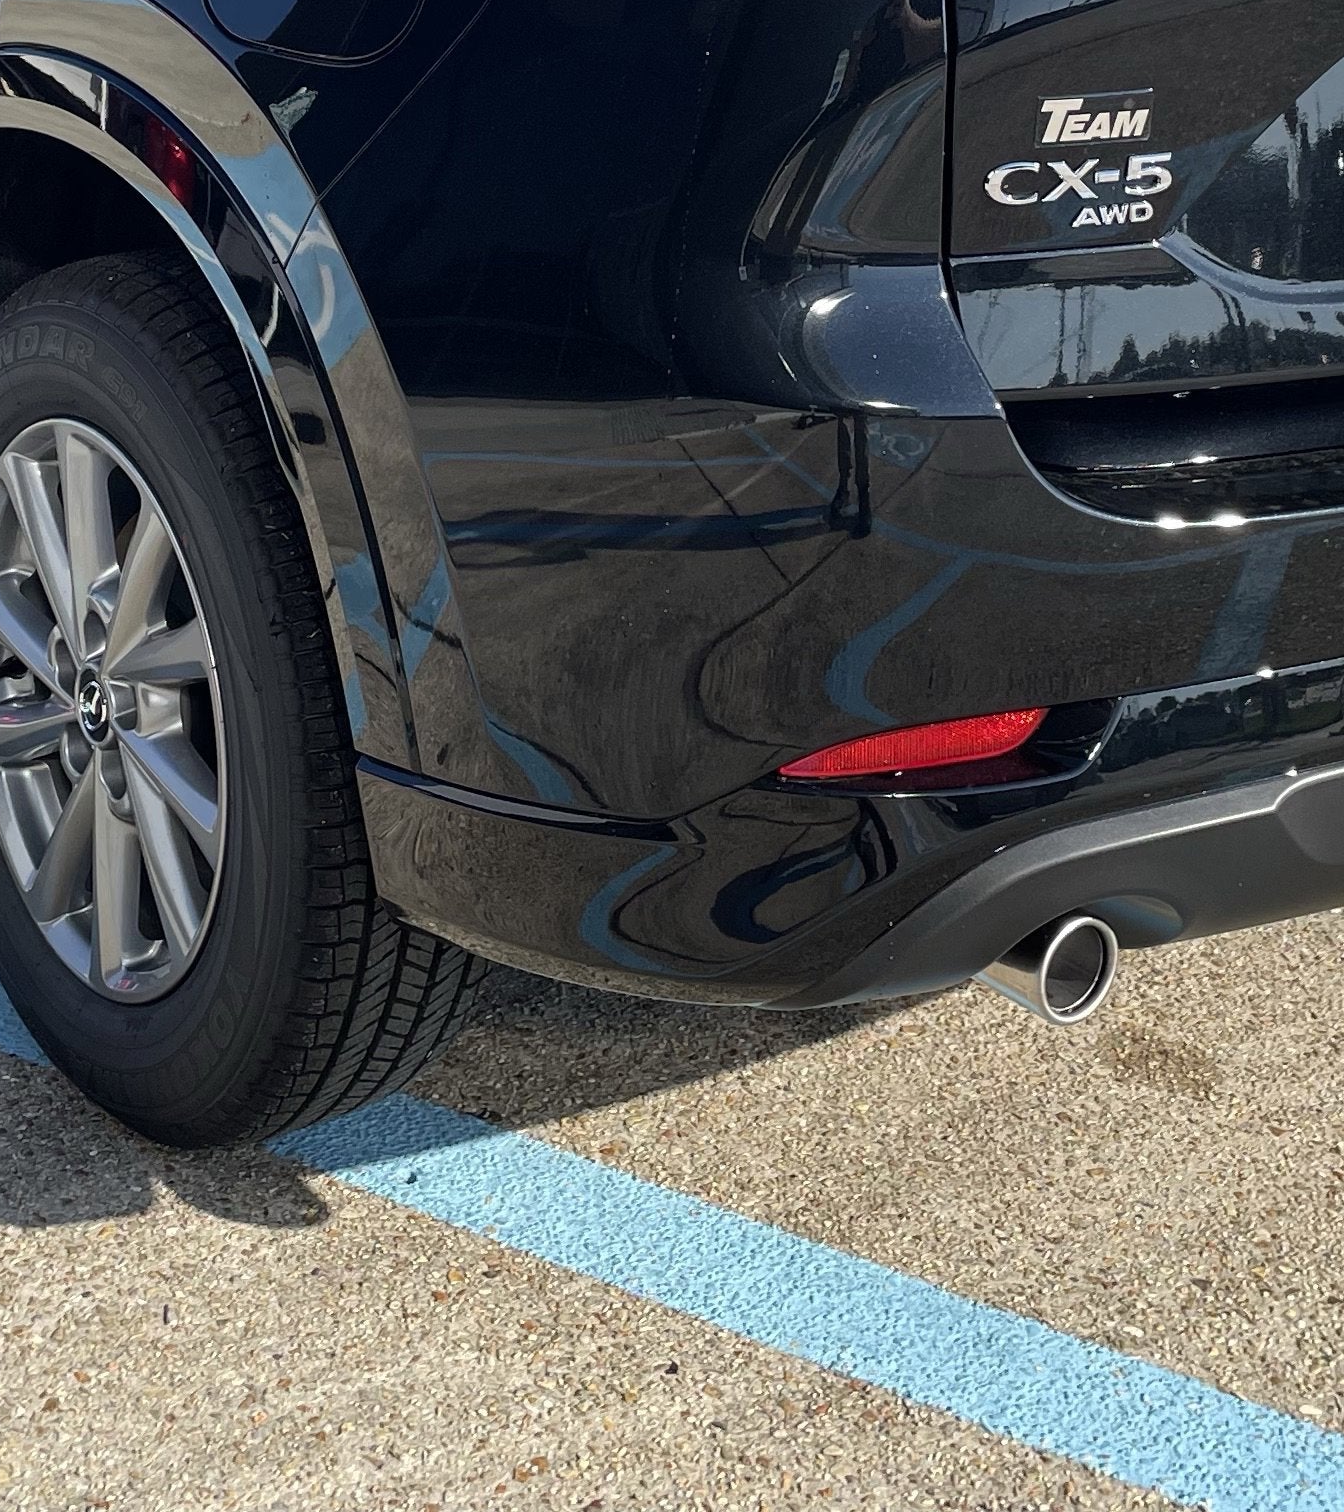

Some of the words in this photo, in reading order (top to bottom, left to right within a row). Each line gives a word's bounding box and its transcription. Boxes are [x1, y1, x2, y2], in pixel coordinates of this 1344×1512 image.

[1041, 98, 1149, 143] TEAM
[984, 151, 1173, 205] CX-5
[1072, 200, 1154, 228] AWD
